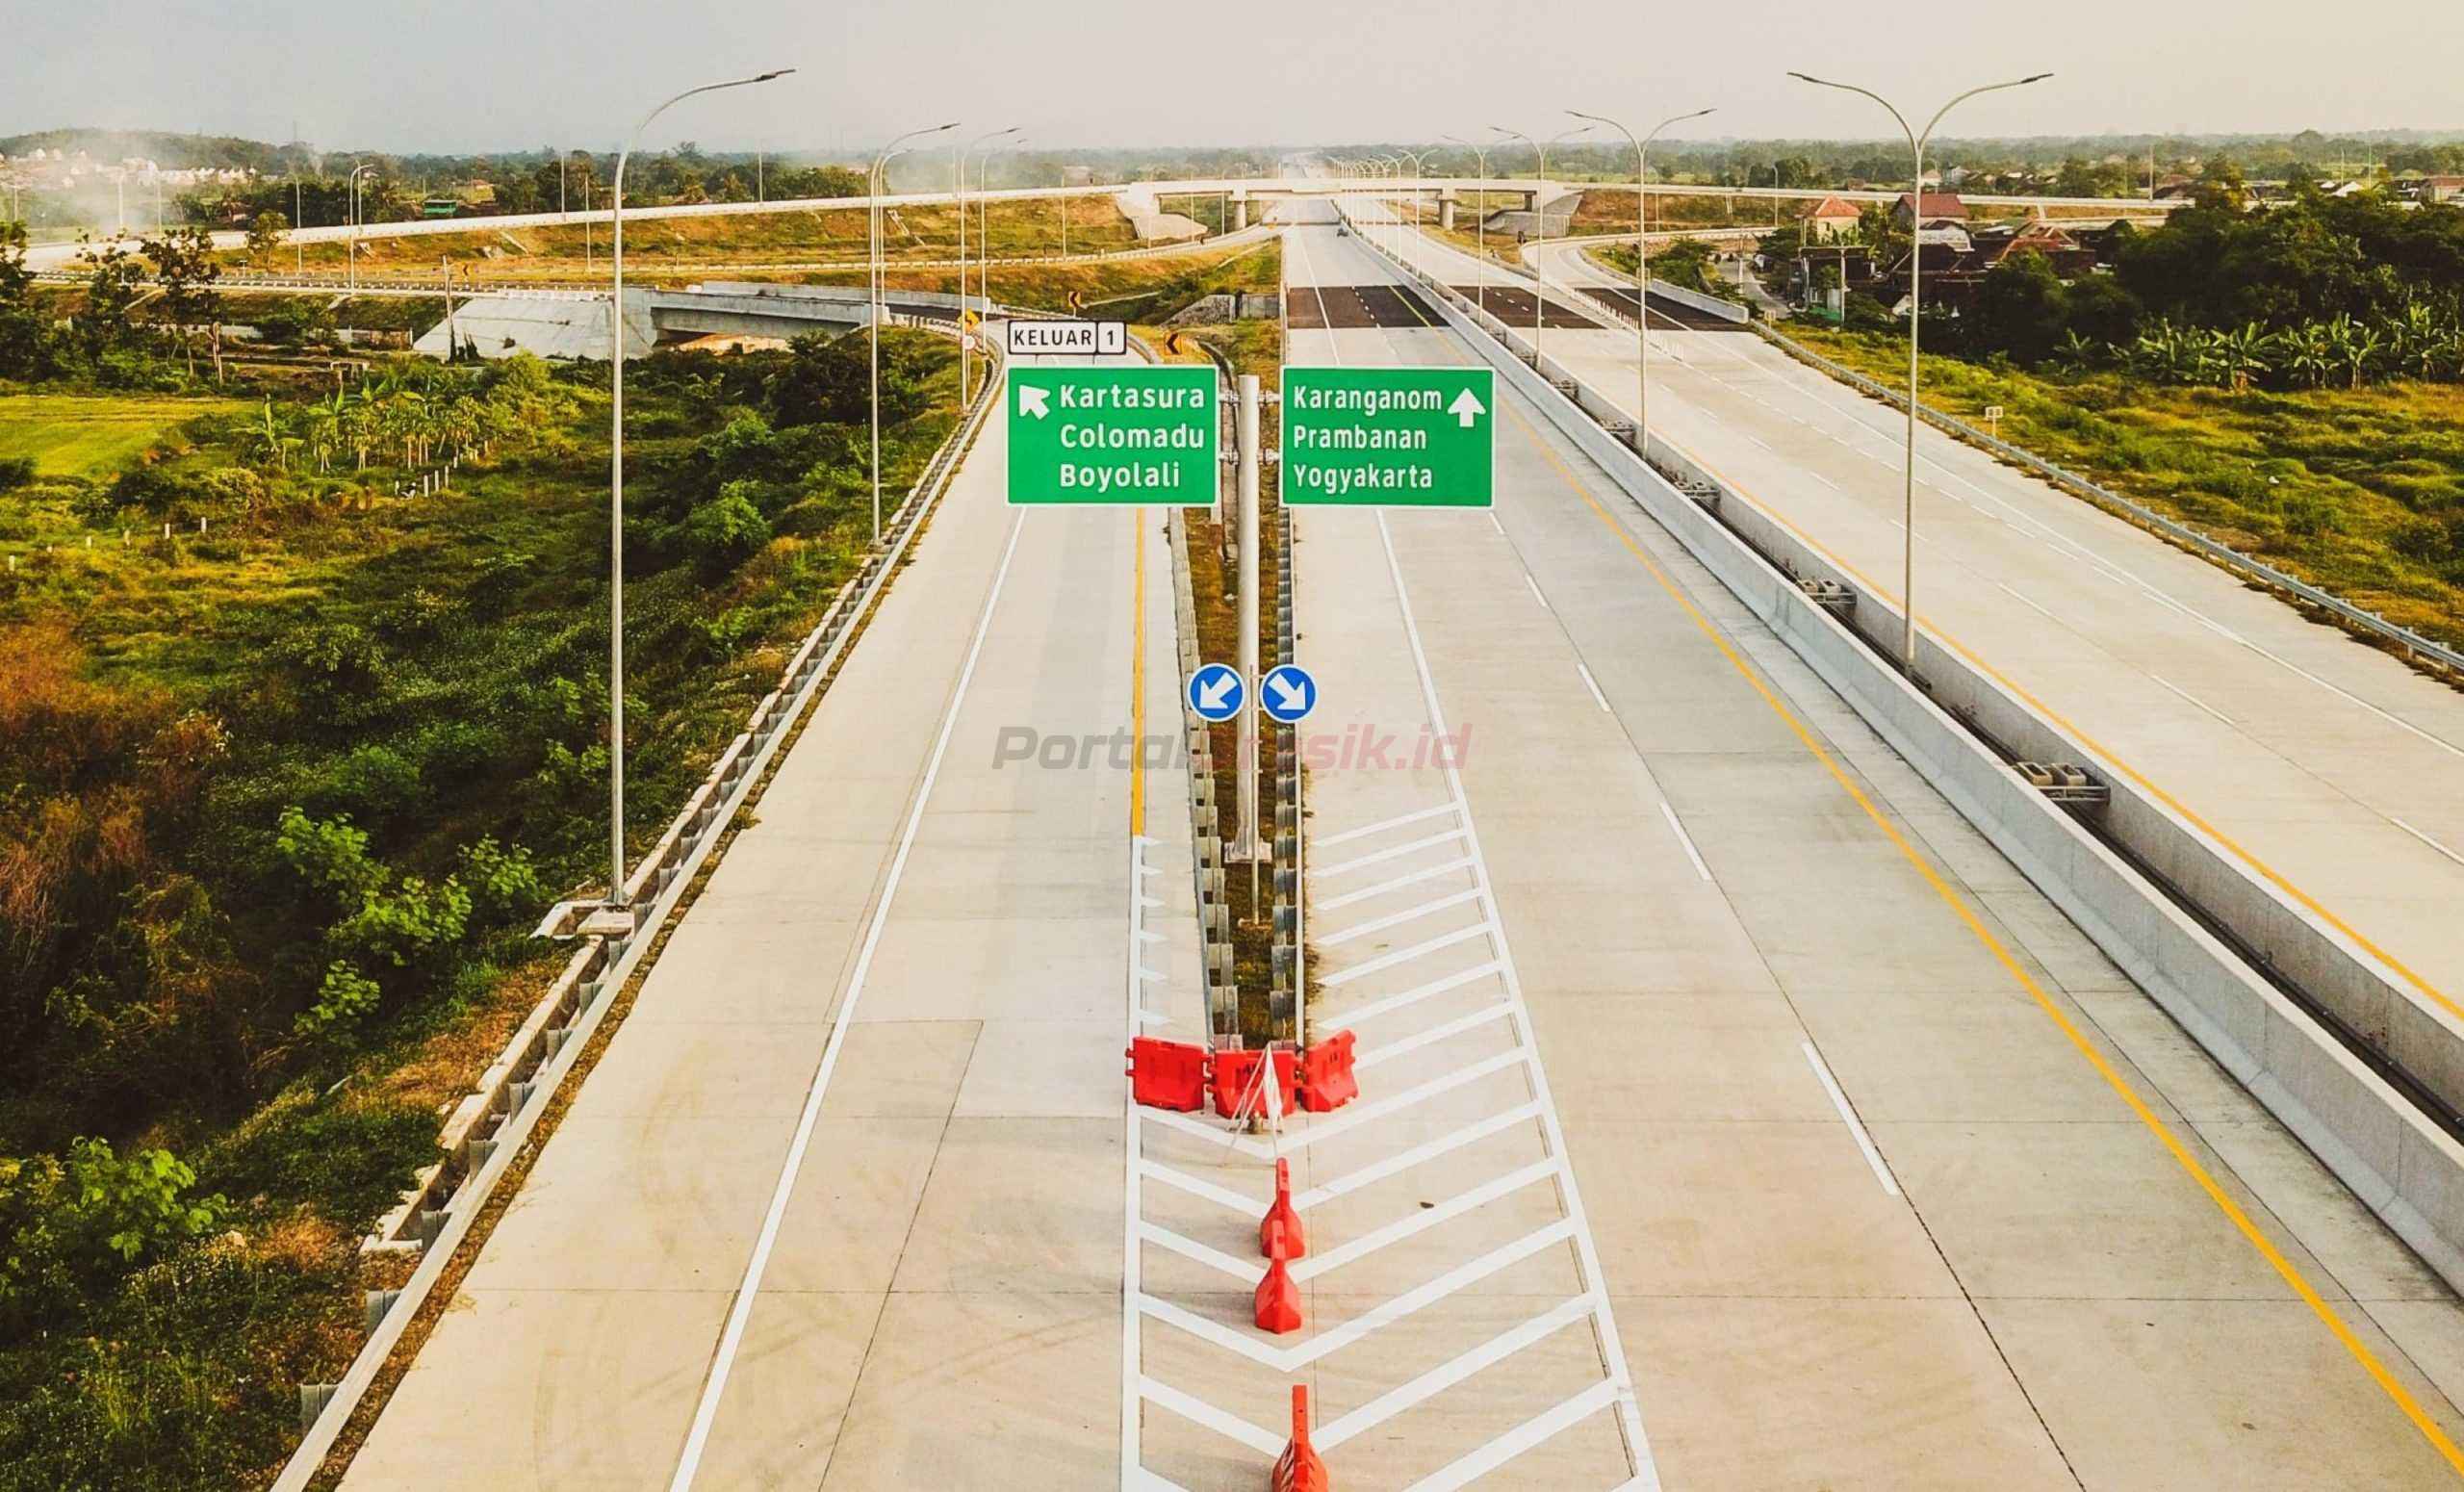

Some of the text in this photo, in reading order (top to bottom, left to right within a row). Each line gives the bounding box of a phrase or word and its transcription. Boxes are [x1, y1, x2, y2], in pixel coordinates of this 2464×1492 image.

[1014, 329, 1115, 346] KELUAR 1
[1060, 385, 1204, 409] Kartasura
[1294, 385, 1442, 416] Karanganom
[1060, 422, 1205, 450] Colomadu
[1294, 424, 1427, 450] Prambanan
[1060, 462, 1180, 493] Boyolali
[1294, 462, 1433, 494] Yogyakarta
